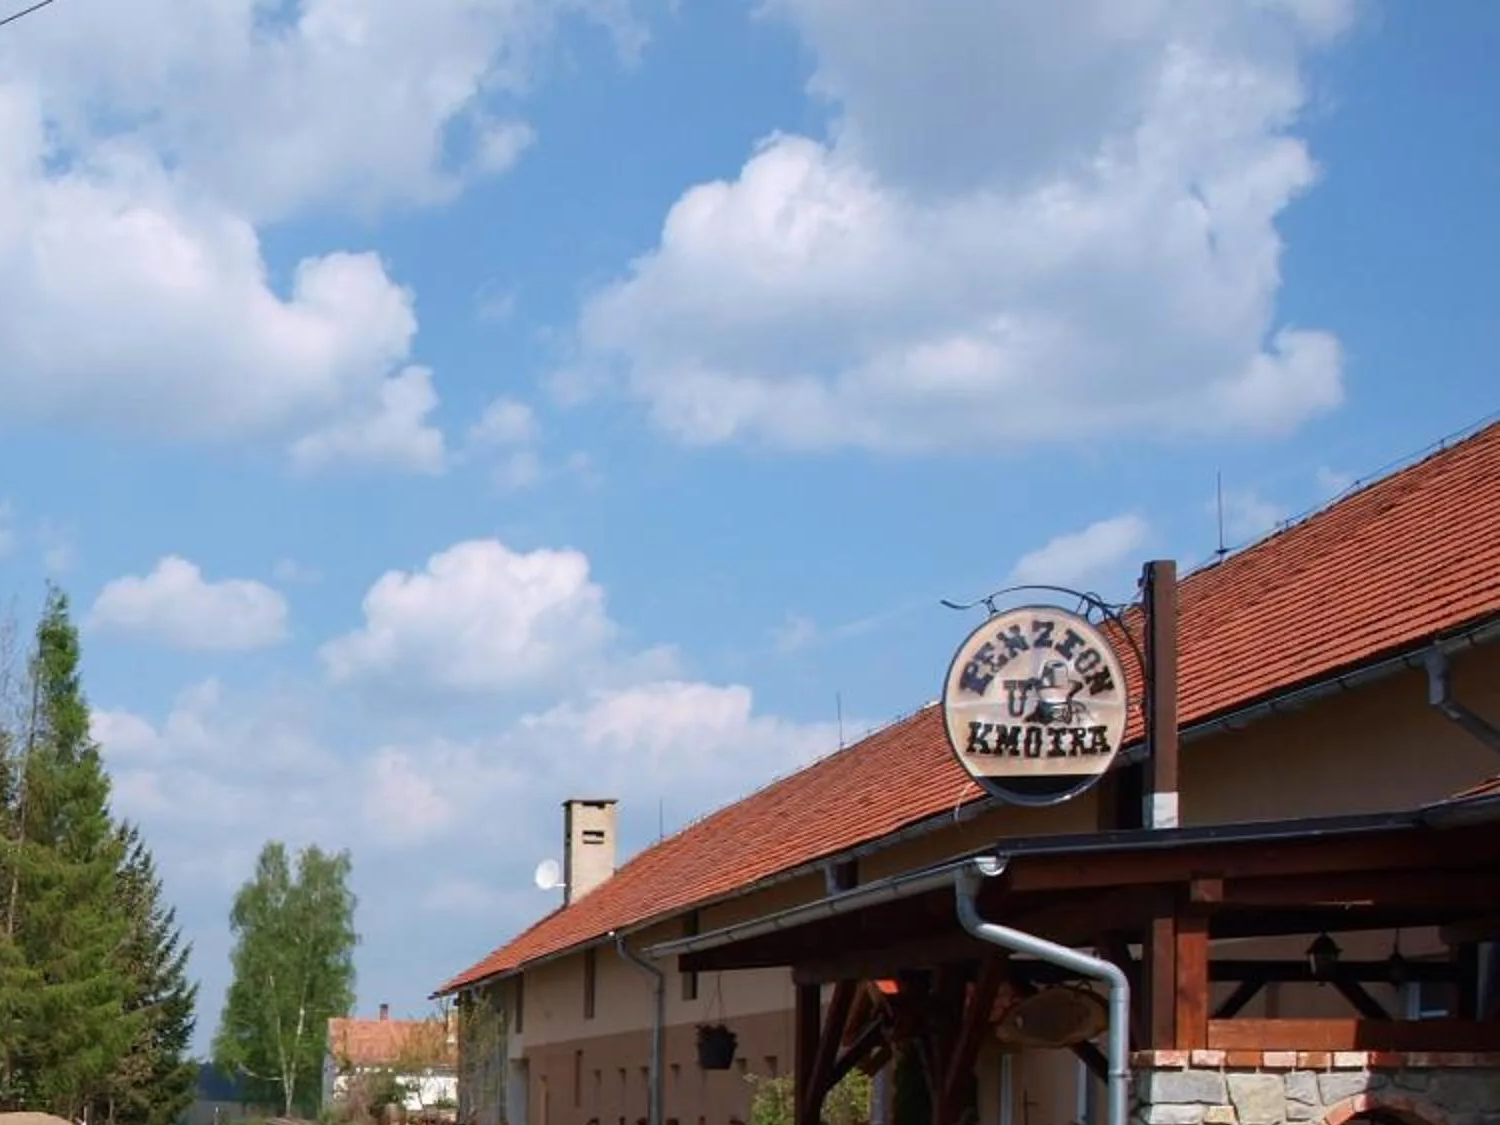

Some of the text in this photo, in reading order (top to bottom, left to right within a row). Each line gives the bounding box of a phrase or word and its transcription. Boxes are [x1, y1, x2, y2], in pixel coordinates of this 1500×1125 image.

[960, 620, 1114, 696] PENZION
[1003, 679, 1038, 718] U
[966, 721, 1111, 758] KMOTRA
